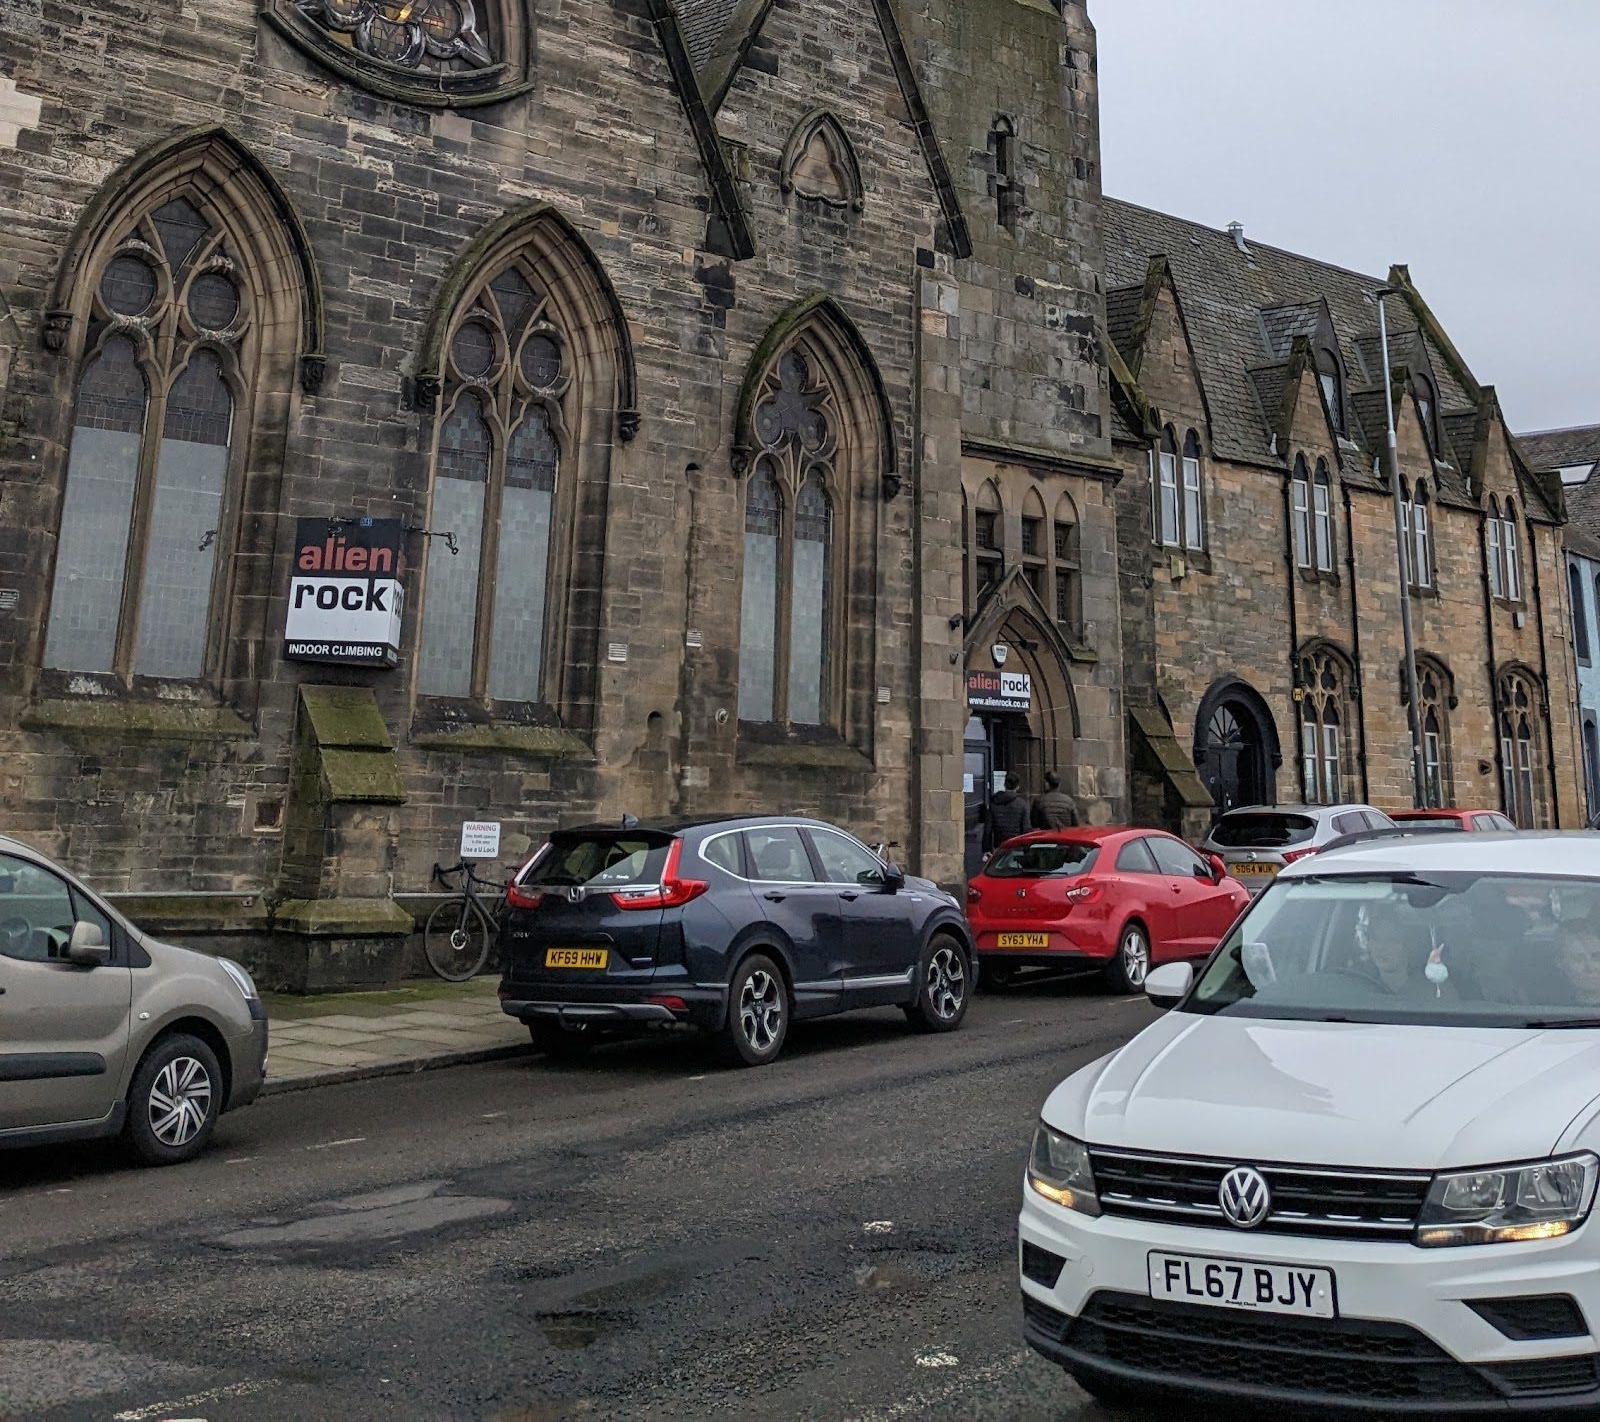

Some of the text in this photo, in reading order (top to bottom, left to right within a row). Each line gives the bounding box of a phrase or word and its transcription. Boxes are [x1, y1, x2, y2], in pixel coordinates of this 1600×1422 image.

[299, 536, 392, 572] alien
[294, 578, 388, 611] rock
[289, 643, 329, 655] INDOOR
[331, 645, 382, 657] CLIMBING
[969, 673, 1029, 692] alien rock
[968, 697, 1029, 709] www.alienrock.co.uk
[466, 824, 497, 832] WARNING
[1001, 934, 1044, 945] SY63 YHA
[550, 950, 603, 966] KF69 HHW
[1164, 1259, 1316, 1308] FL67 BJY
